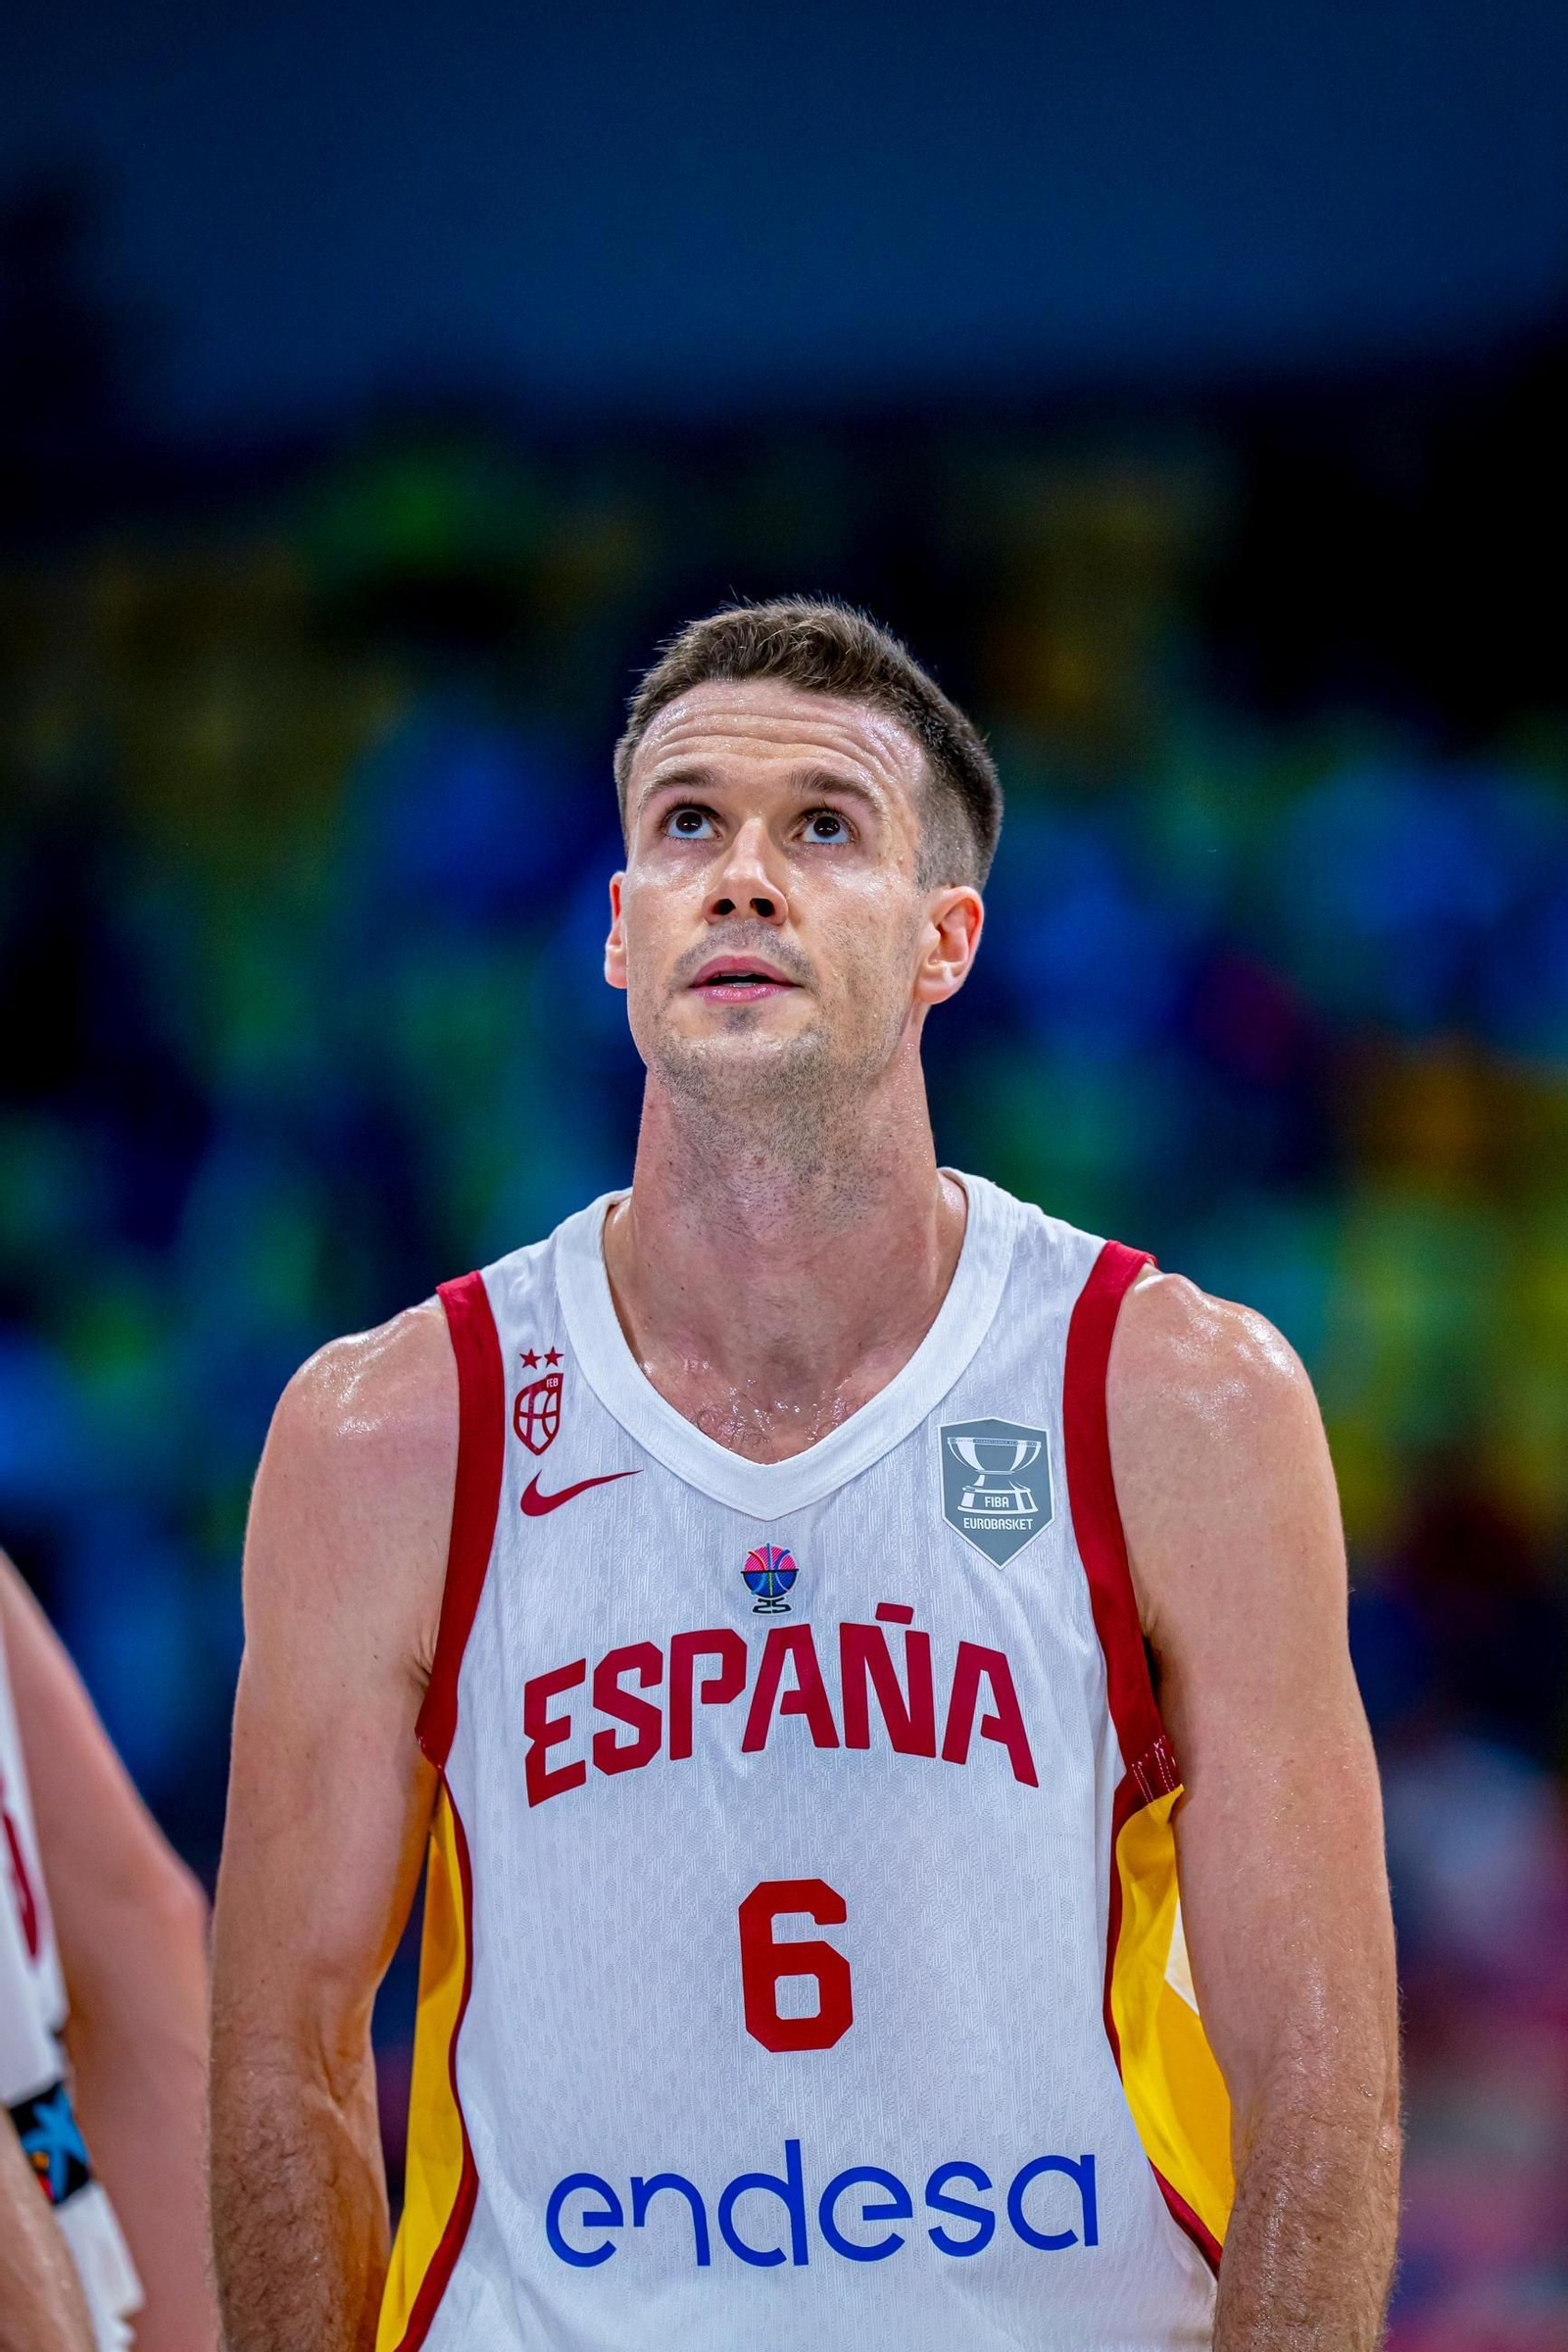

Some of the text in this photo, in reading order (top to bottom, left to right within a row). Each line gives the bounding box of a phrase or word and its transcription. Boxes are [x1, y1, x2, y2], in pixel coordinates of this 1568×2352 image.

[546, 1378, 559, 1388] FEB
[963, 1517, 1033, 1530] EUROBASKET
[984, 1495, 1009, 1508] FIBA
[524, 1603, 1038, 1807] ESPAÑA
[739, 1879, 853, 2052] 6
[545, 2138, 1100, 2269] endesa
